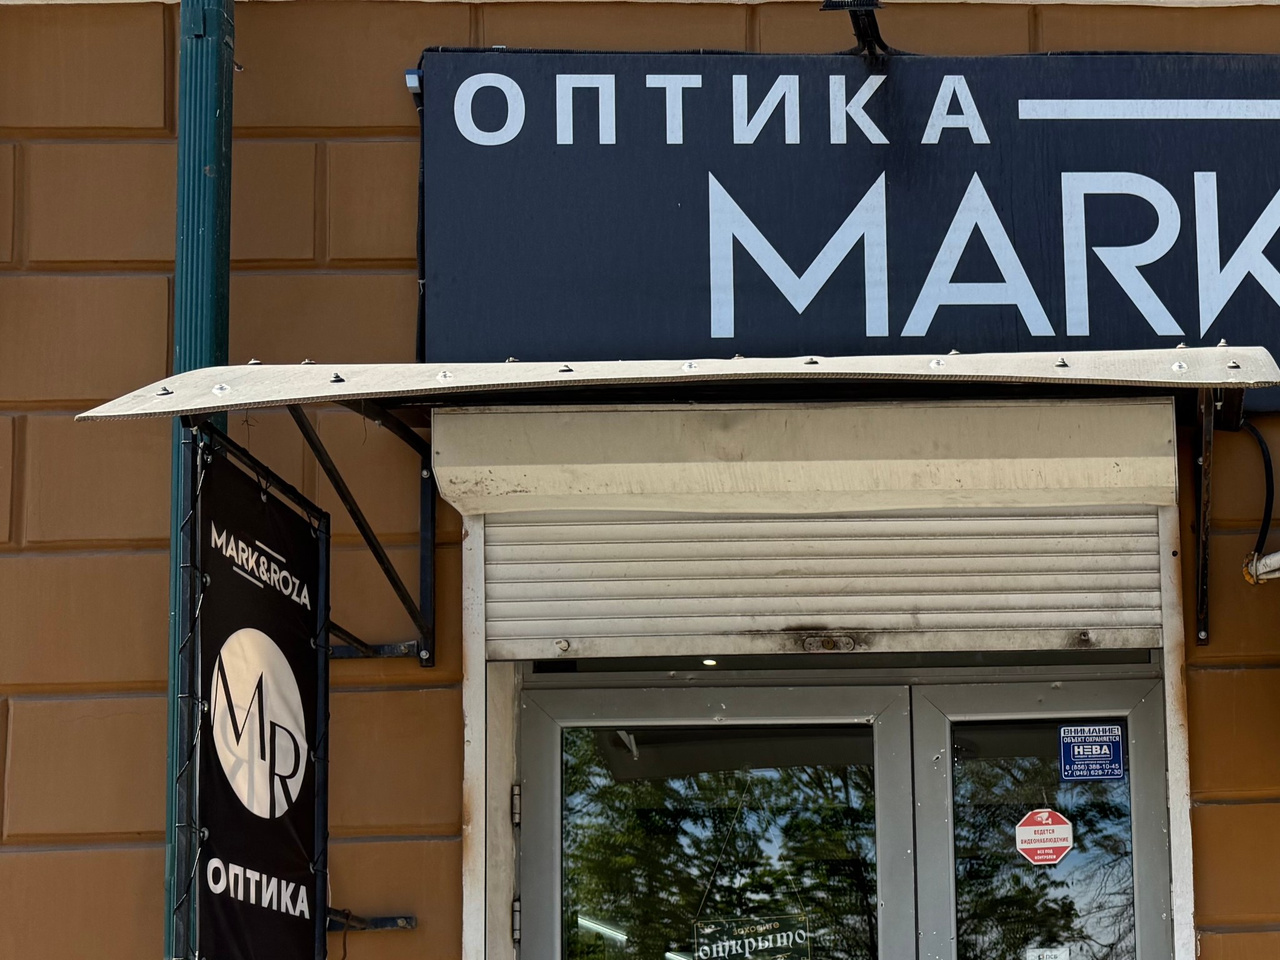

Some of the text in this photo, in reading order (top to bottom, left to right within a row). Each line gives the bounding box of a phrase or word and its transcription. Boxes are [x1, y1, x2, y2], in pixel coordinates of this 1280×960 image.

[453, 72, 991, 146] ОПТИКА
[211, 520, 311, 611] MARK&ROZA
[1063, 727, 1119, 735] ВНИМАНИЕ!
[1074, 745, 1110, 755] НЕВА
[1020, 837, 1069, 845] ВИДЕОНАБЛЮДЕНИЕ
[206, 857, 310, 920] ОПТИКА
